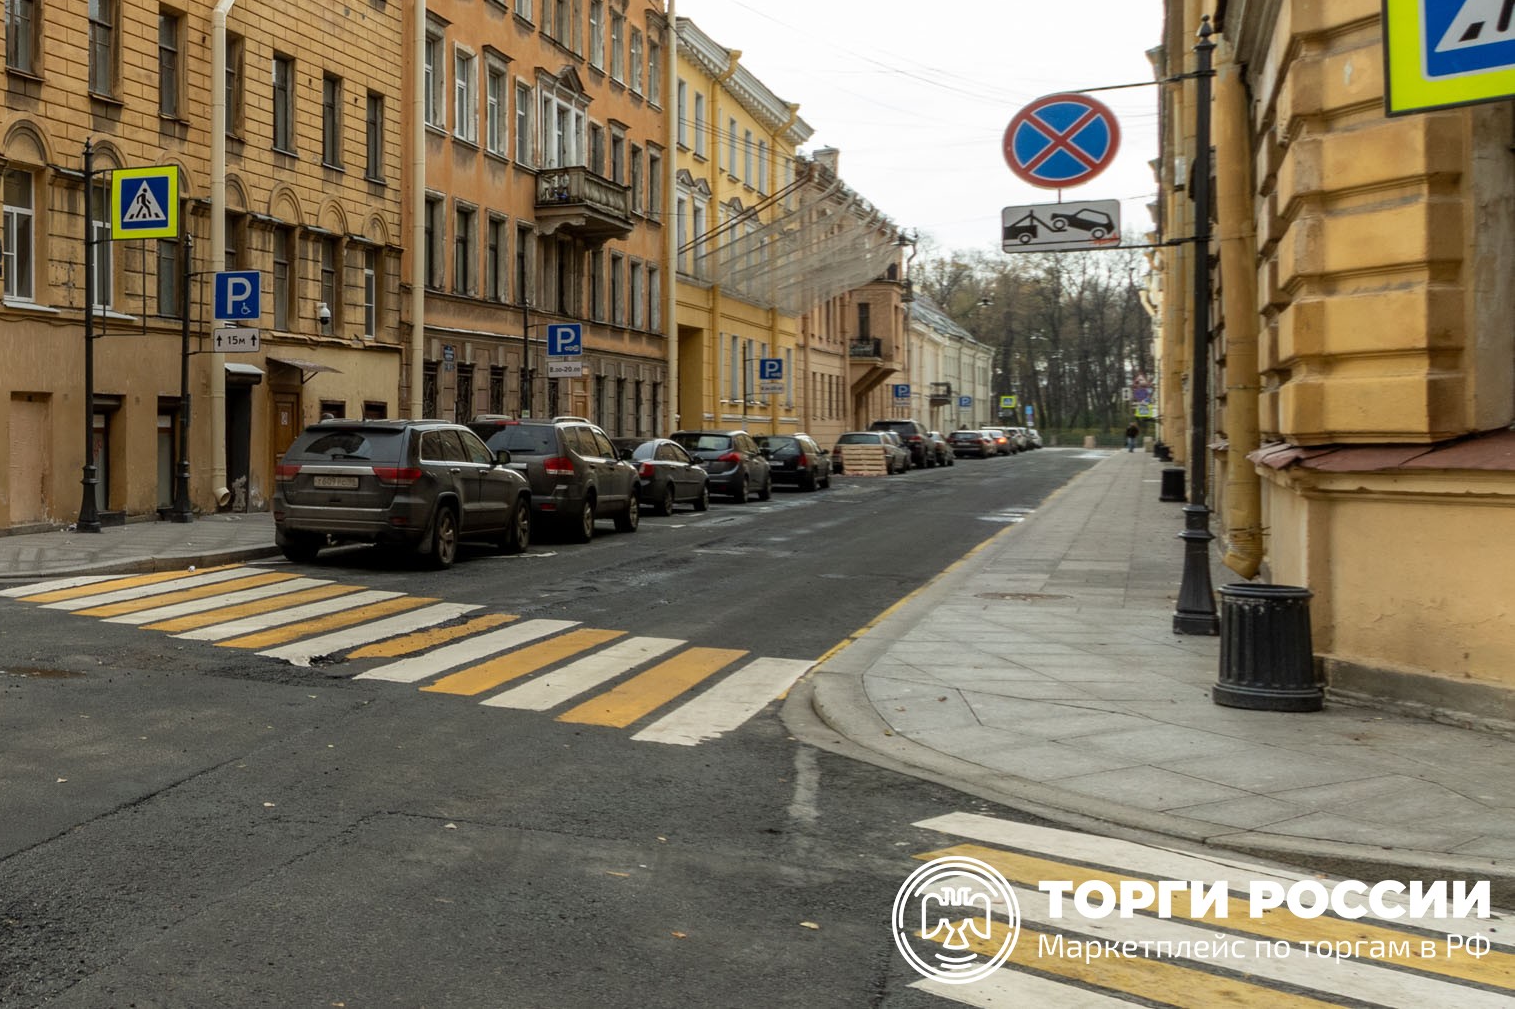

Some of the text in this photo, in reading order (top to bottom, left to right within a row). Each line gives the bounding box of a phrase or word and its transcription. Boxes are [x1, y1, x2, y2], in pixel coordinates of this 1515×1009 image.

[227, 277, 252, 315] P
[557, 328, 575, 352] P
[765, 361, 779, 378] P
